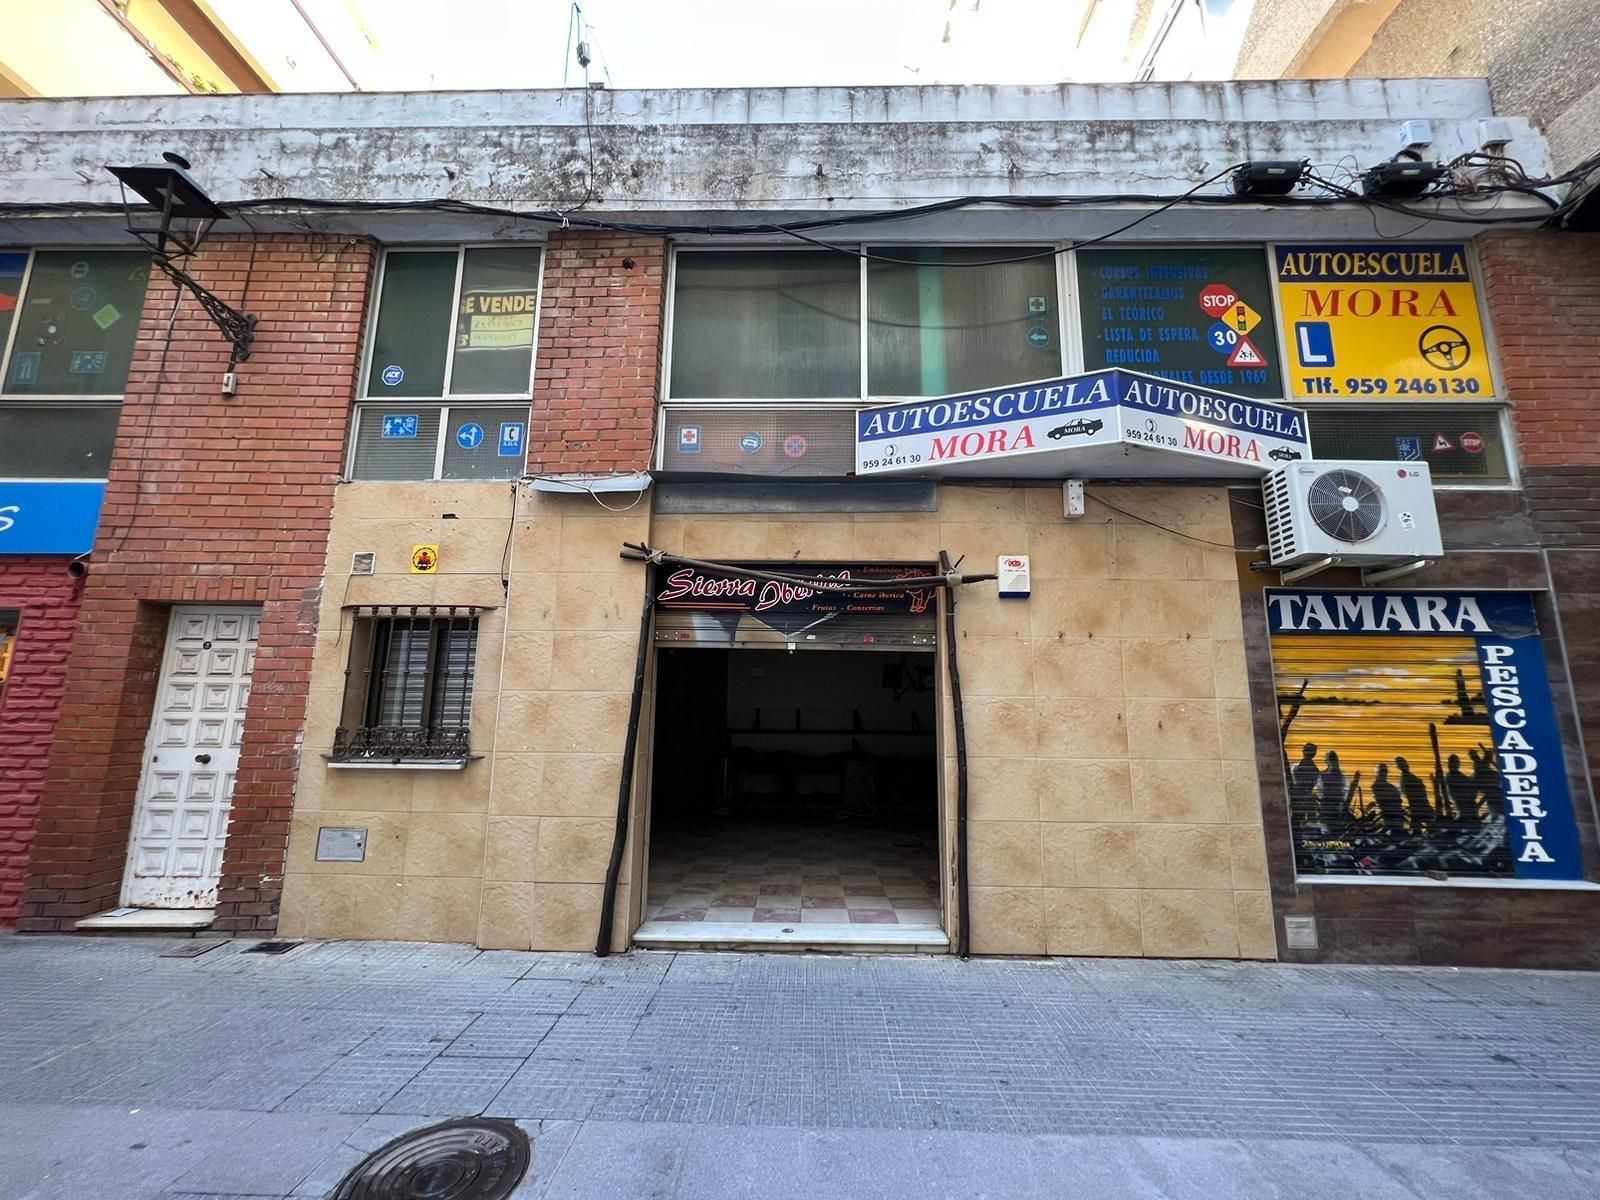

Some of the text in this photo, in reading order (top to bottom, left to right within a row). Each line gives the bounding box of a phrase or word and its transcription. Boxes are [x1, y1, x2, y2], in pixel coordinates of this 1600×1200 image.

[1280, 252, 1465, 276] AUTOESCUELA
[1100, 266, 1209, 280] CURSOS INTENSIVOS
[1102, 286, 1184, 300] GARANTIZAMOS
[1203, 294, 1235, 307] STOP
[480, 295, 536, 313] VENDE
[1300, 288, 1460, 317] MORA
[1102, 304, 1165, 321] EL TEÓRICO
[1105, 327, 1199, 342] LISTA DE ESPERA
[1214, 330, 1237, 346] 30
[1106, 349, 1160, 363] REDUCIDA
[1200, 370, 1234, 384] DESDE
[1240, 369, 1267, 384] 1969
[1302, 377, 1480, 394] Tlf. 959 246130
[863, 378, 1111, 437] AUTOESCUELA
[1124, 380, 1304, 438] AUTOESCUELA
[1063, 425, 1086, 434] MORA
[1126, 429, 1178, 446] 959 24 61 30
[928, 424, 1036, 461] MORA
[1183, 425, 1261, 462] MORA
[1463, 438, 1481, 446] STOP
[863, 454, 921, 469] 959 24 61 30
[657, 568, 756, 601] Sierra
[1268, 594, 1493, 632] TAMARA
[1481, 645, 1555, 863] PESCADERIA
